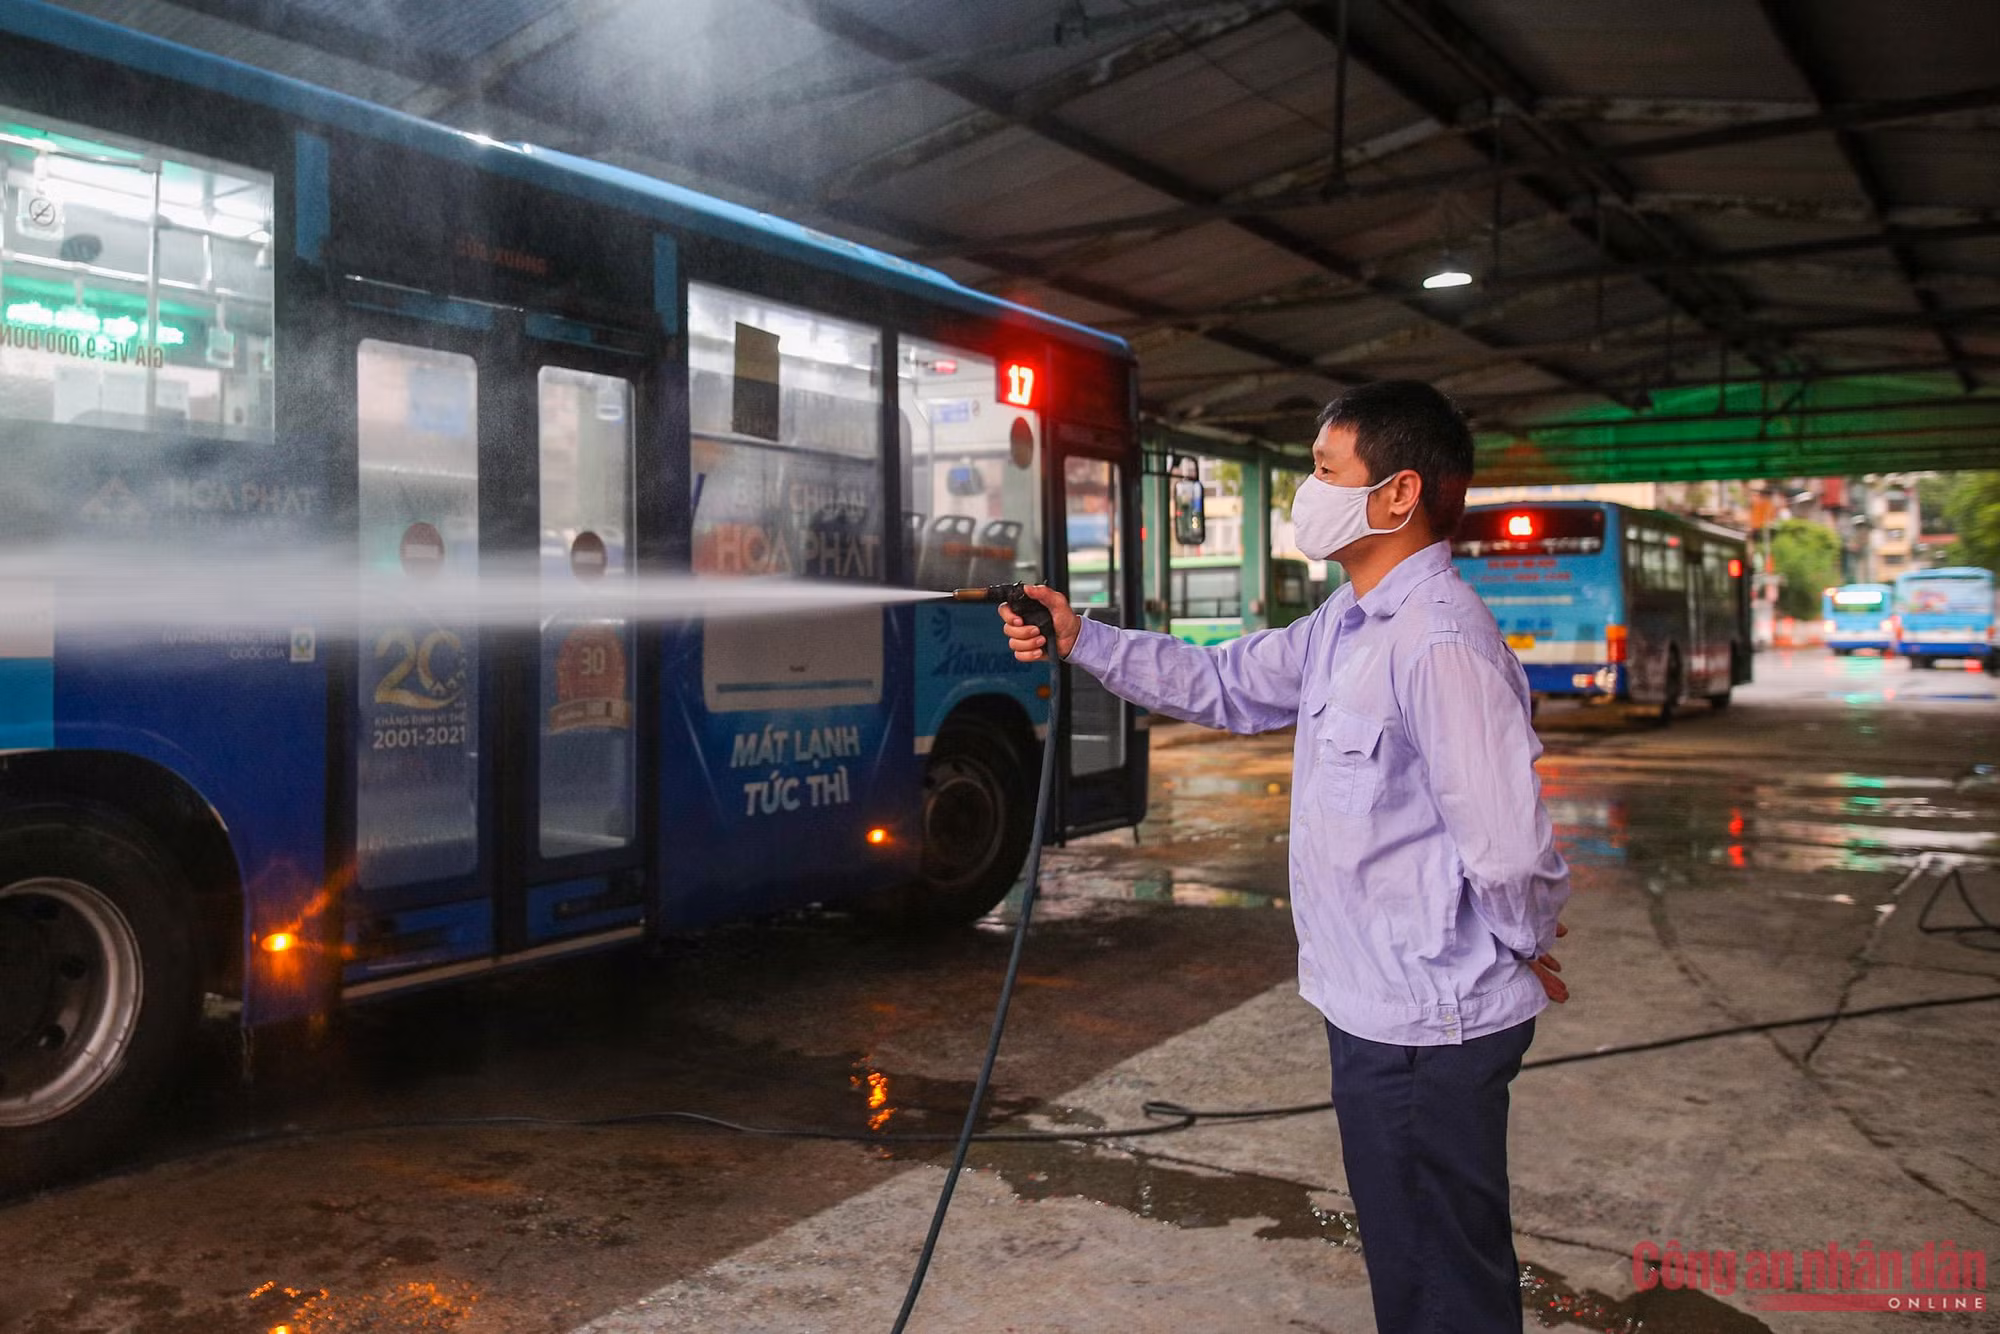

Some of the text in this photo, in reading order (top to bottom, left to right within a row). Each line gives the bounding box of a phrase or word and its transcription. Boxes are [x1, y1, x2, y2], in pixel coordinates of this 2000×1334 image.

[1007, 364, 1034, 406] 17
[580, 646, 606, 675] 30
[373, 725, 466, 749] 2001-2021
[730, 724, 861, 768] MÁT LẠNH
[744, 765, 849, 816] TỨC THÌ
